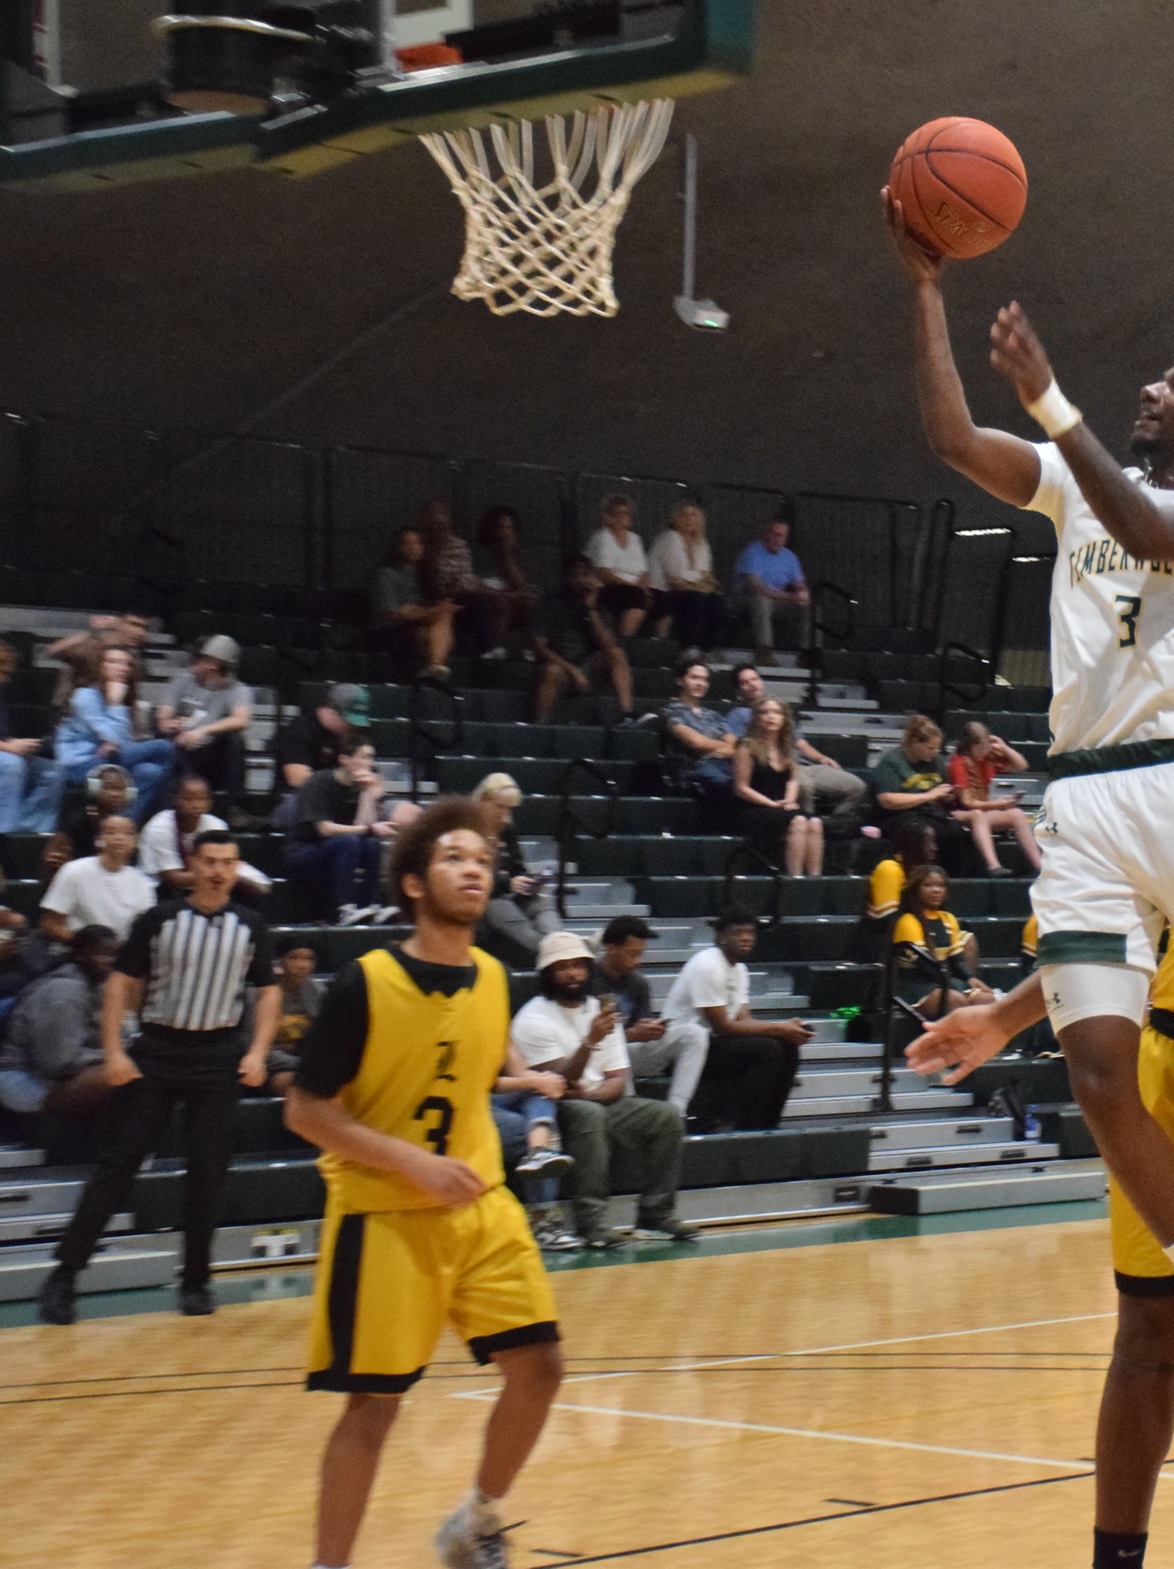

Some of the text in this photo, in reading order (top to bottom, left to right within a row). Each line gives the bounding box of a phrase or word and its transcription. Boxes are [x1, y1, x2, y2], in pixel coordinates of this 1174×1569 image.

[931, 200, 995, 251] SPALD
[1114, 594, 1142, 648] 3
[413, 1095, 454, 1156] 3
